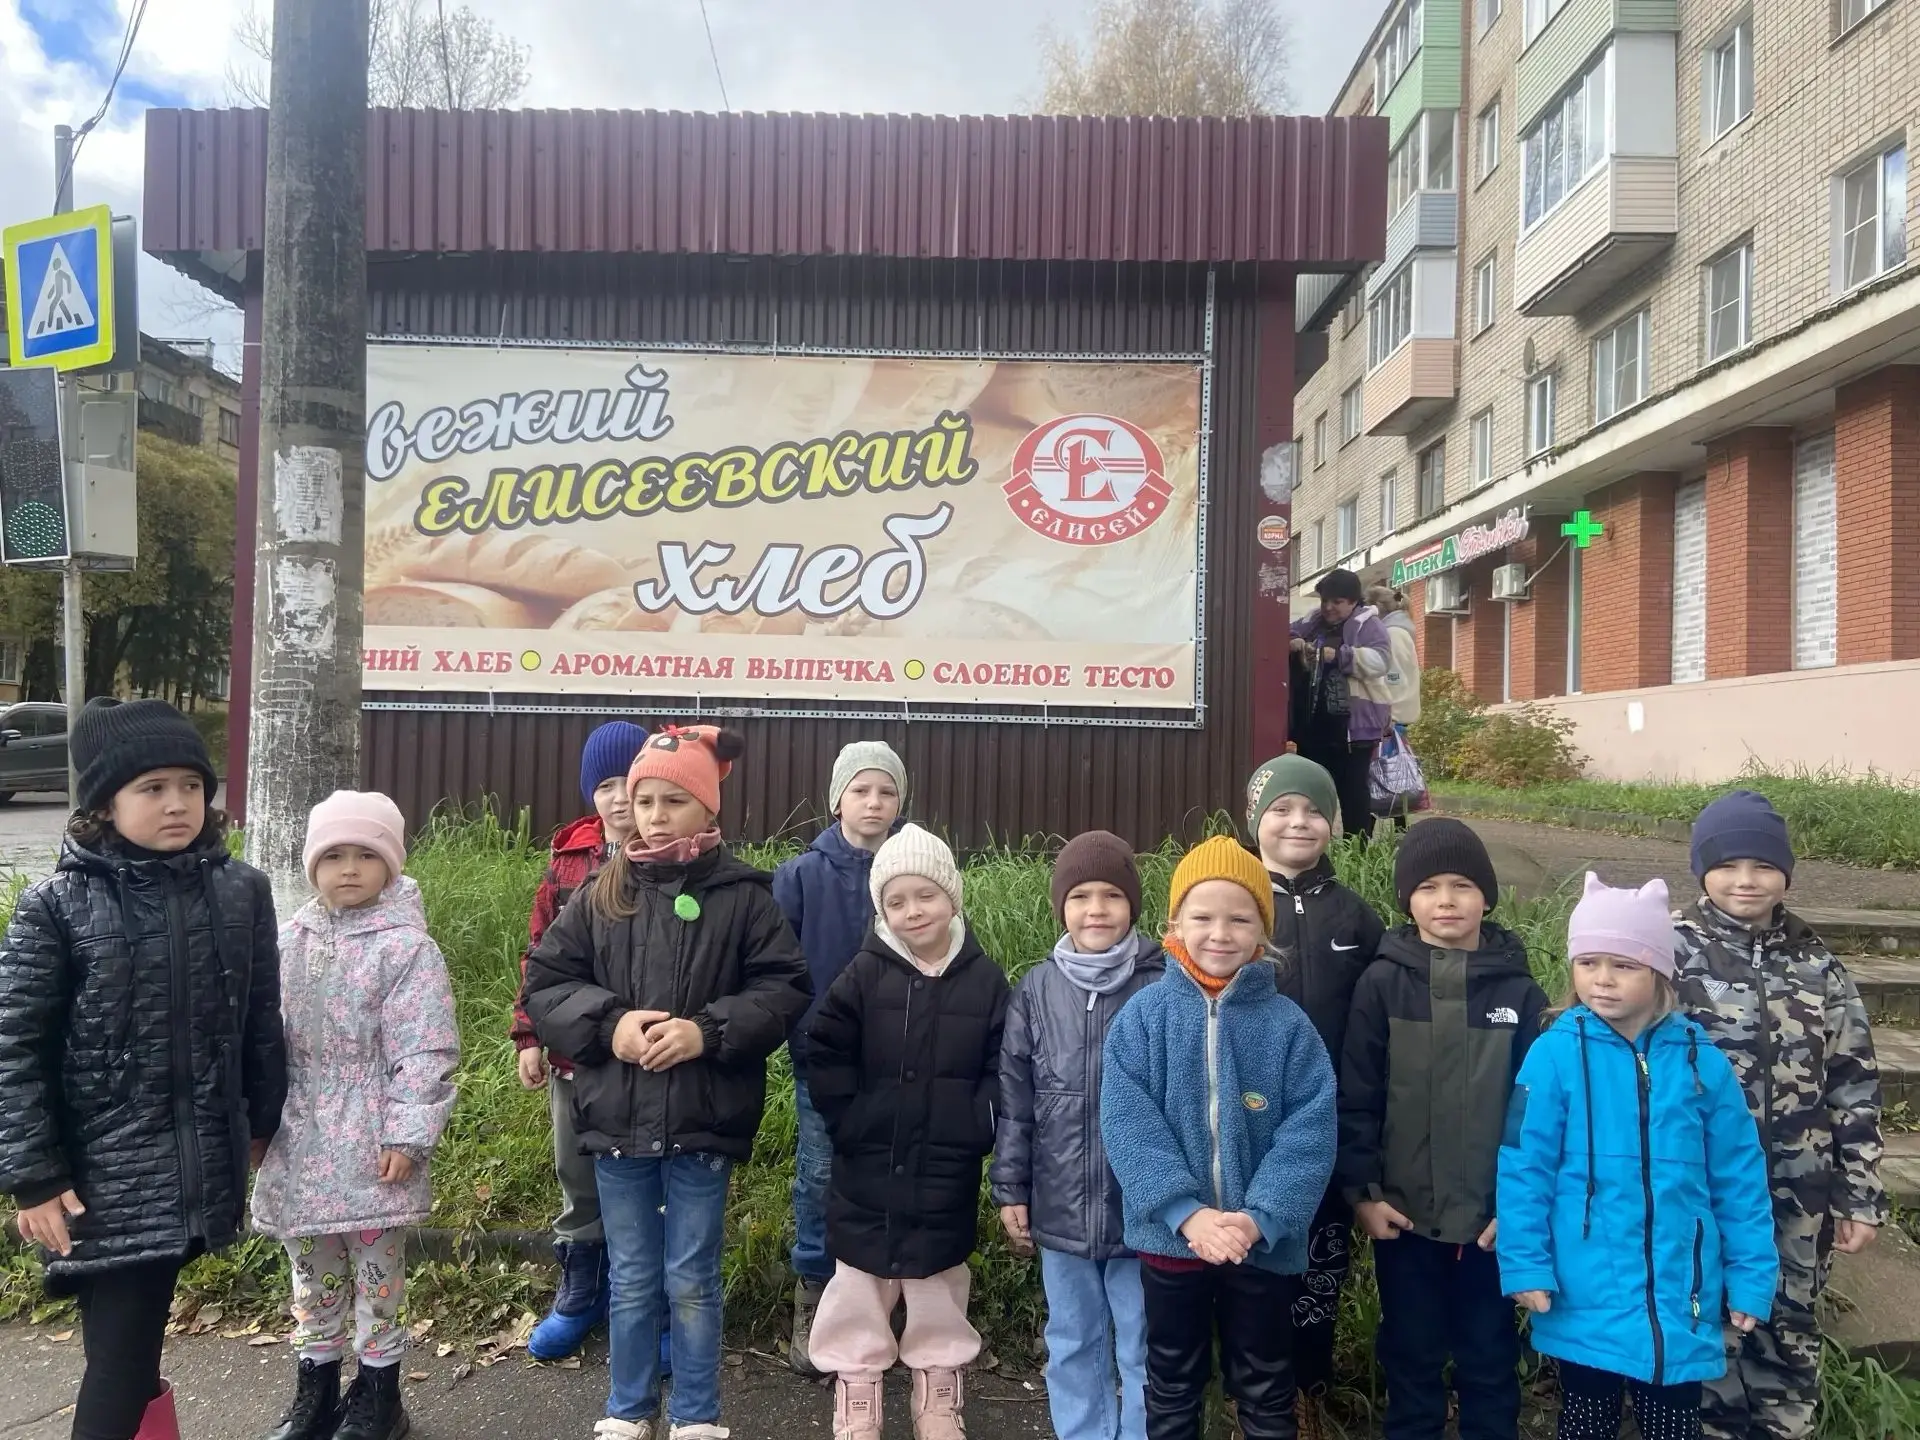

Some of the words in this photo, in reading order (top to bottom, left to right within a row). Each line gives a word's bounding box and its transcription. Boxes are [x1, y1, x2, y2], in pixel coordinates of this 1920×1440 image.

[367, 364, 674, 481] вежий
[414, 410, 979, 536] ЕЛИСЕЕВСКИЙ
[633, 501, 954, 620] хлеб
[1030, 506, 1149, 541] ЕЛИСЕЙ
[432, 649, 513, 673] ХЛЕБ
[550, 653, 734, 679] АРОМАТНАЯ
[747, 657, 895, 683] ВЫПЕЧКА
[932, 662, 1071, 688] СЛОЕНОЕ
[1084, 664, 1175, 689] ТЕСТО
